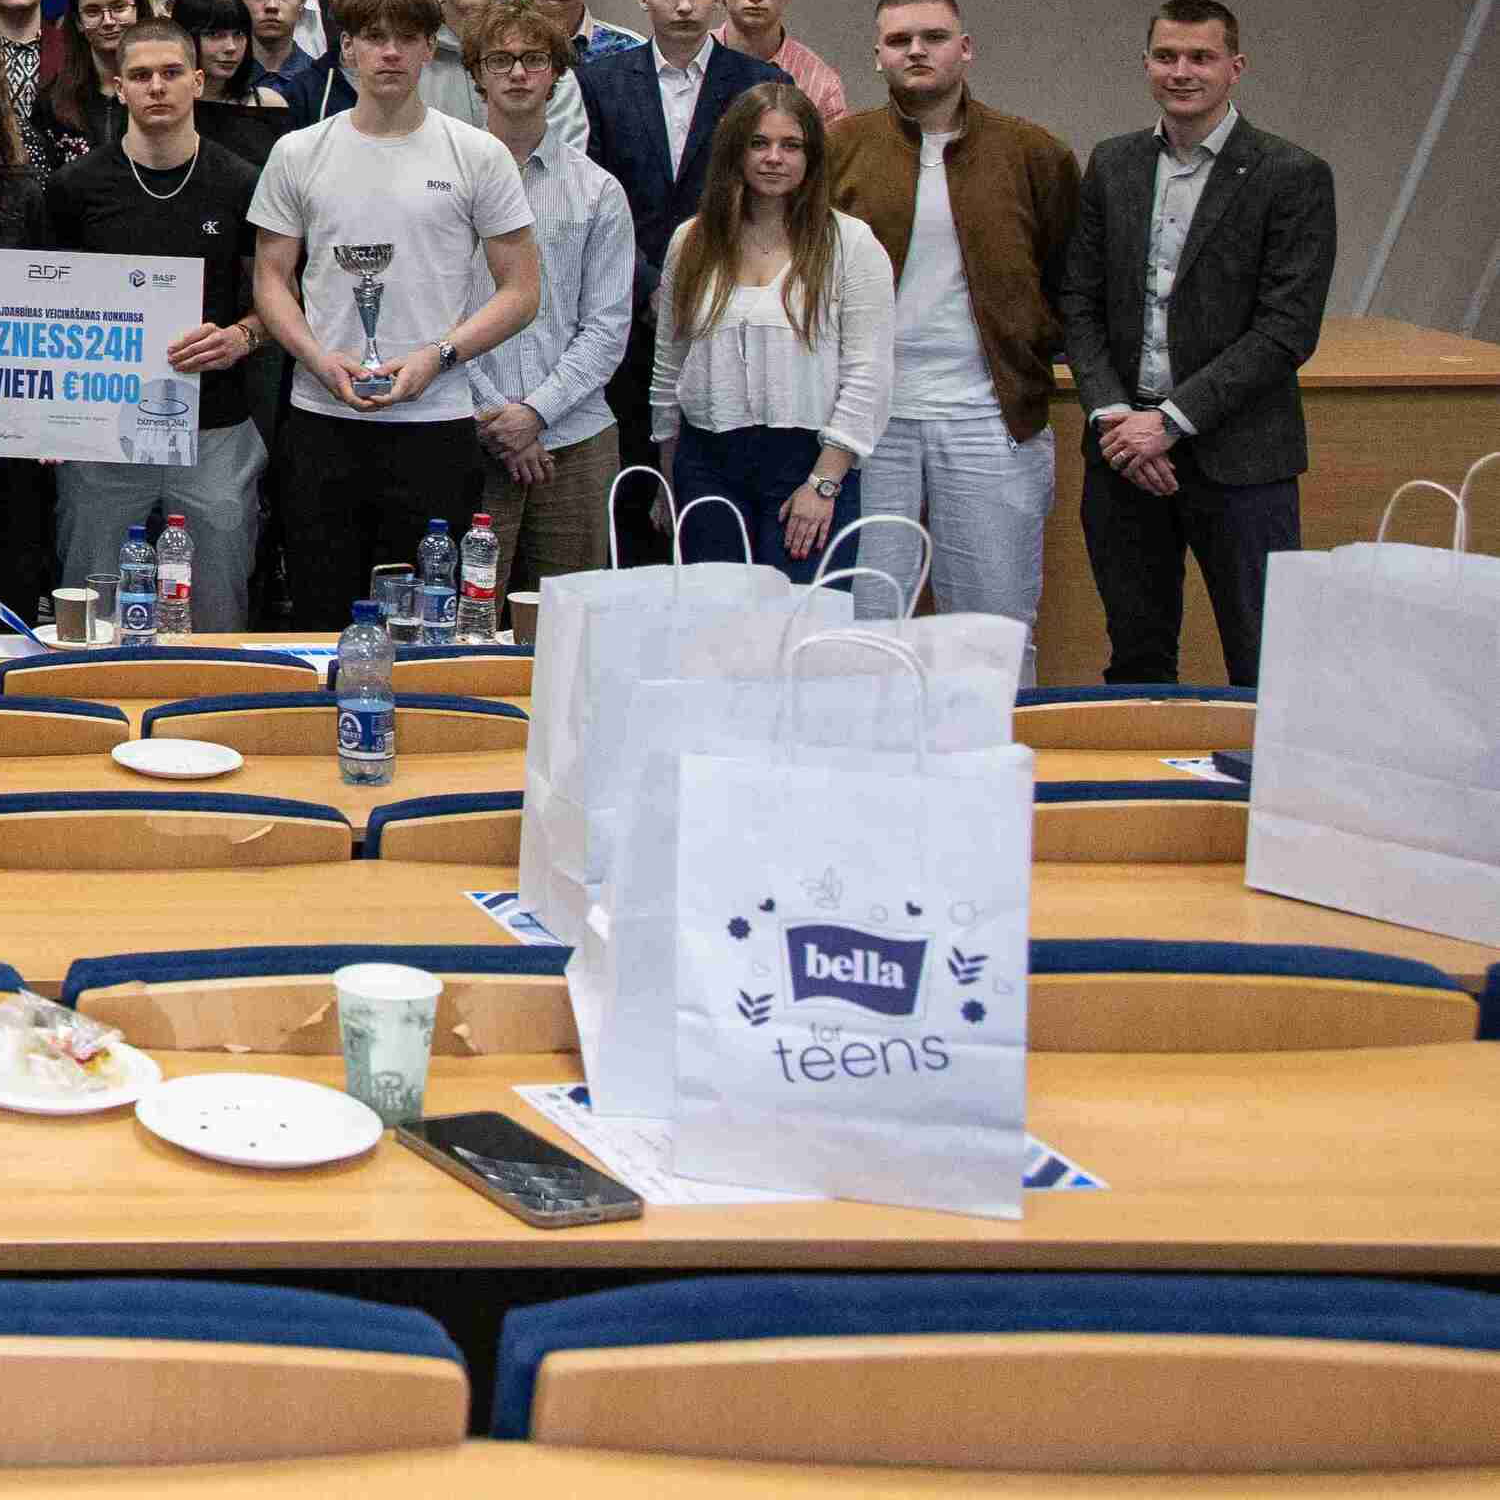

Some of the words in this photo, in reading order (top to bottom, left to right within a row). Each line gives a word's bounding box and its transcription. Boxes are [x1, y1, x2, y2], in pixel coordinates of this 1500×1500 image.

[427, 180, 452, 190] BOSS
[28, 264, 72, 280] BDF
[62, 371, 142, 404] €1000
[804, 943, 906, 990] bella
[810, 1022, 843, 1043] for
[773, 1035, 950, 1083] teens
